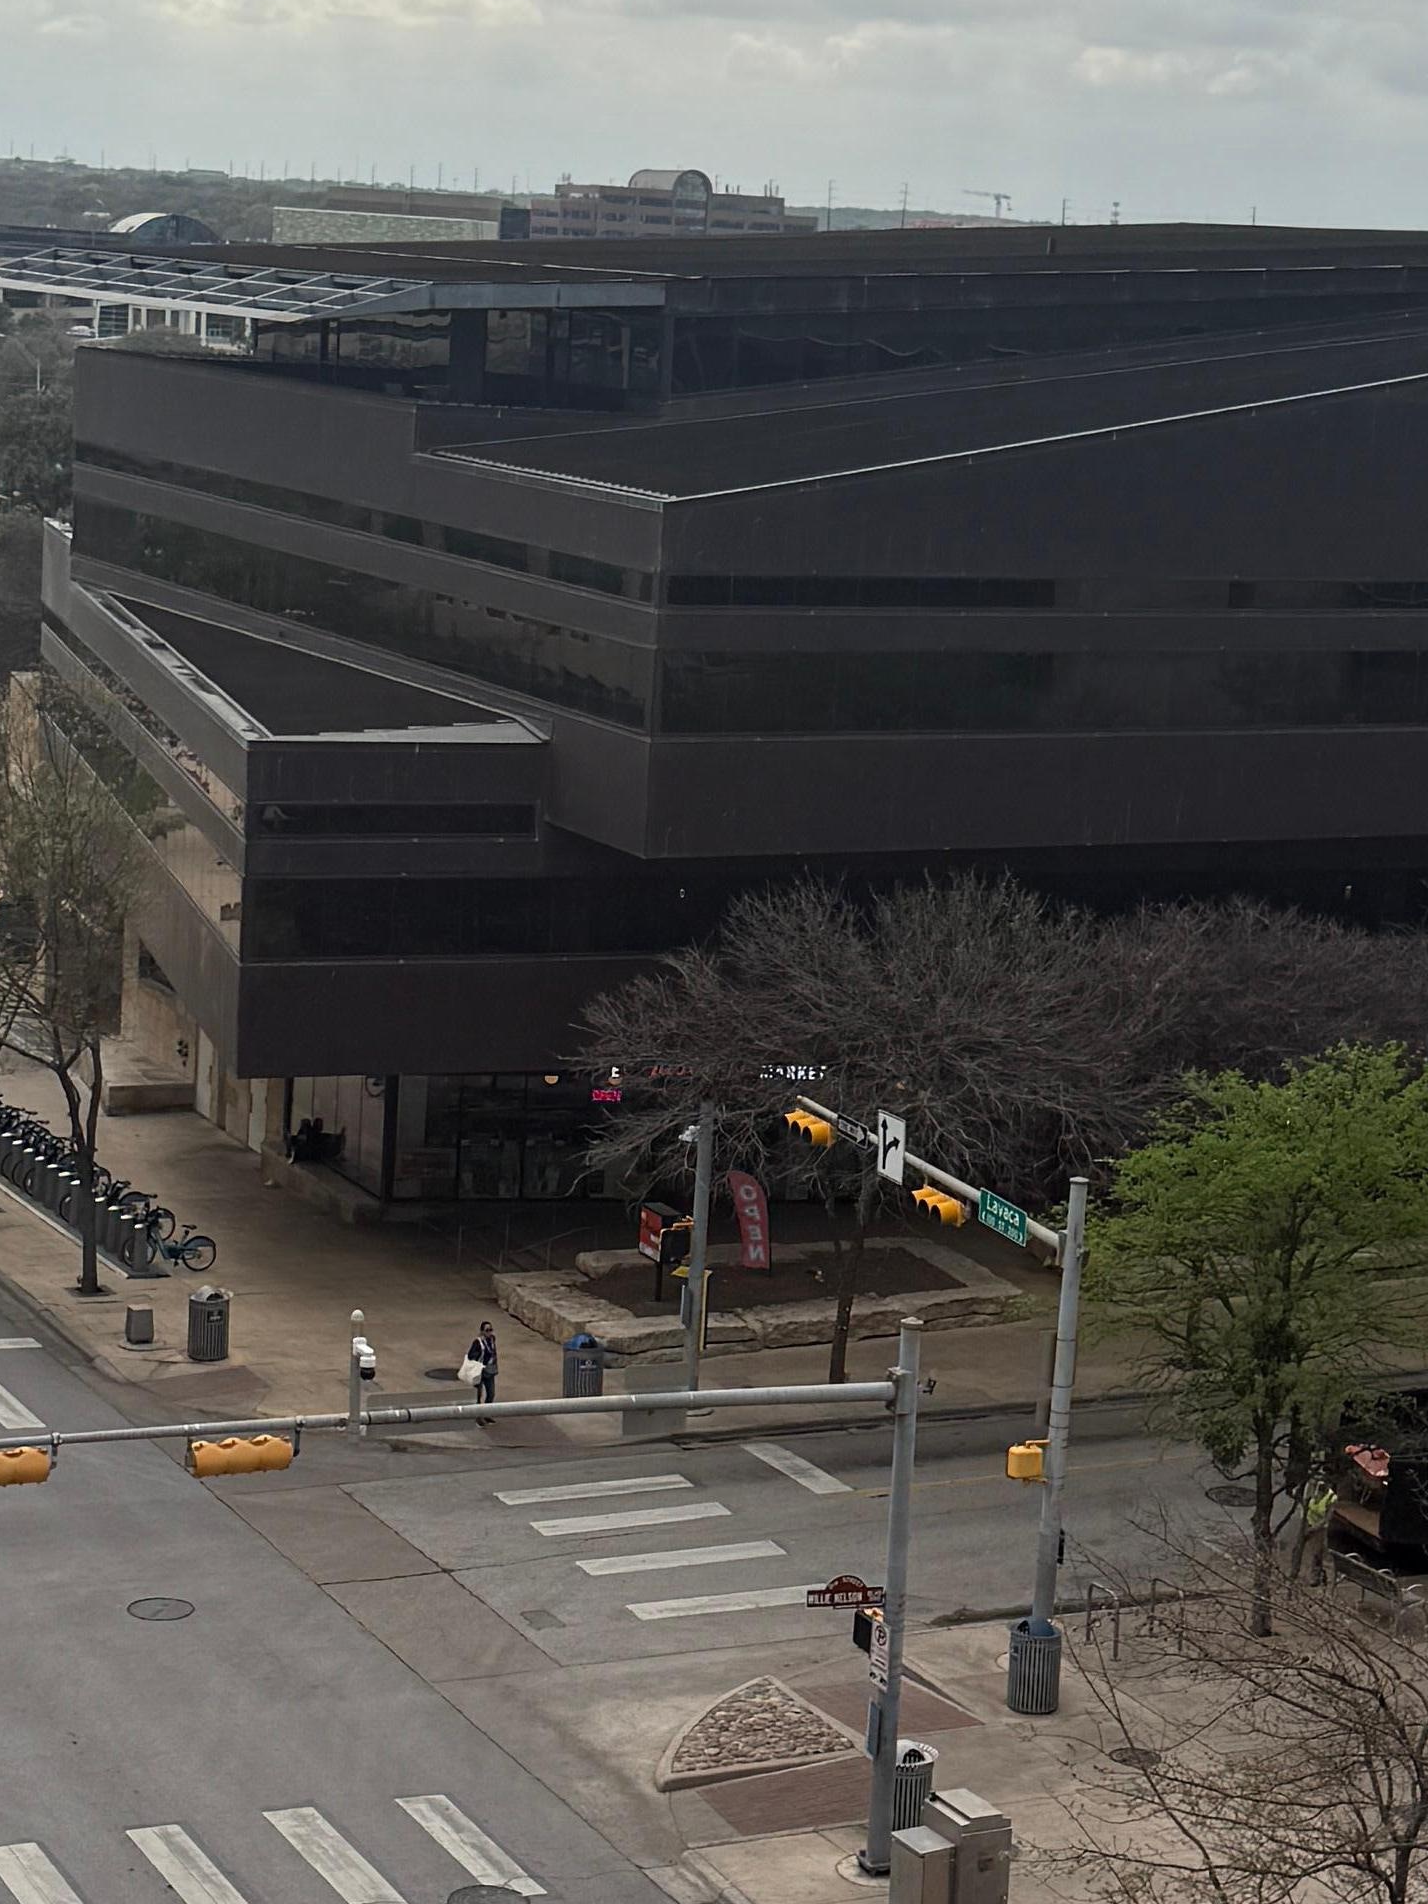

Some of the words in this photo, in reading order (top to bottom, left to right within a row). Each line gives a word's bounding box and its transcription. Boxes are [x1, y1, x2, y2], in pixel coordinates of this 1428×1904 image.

[591, 1089, 623, 1103] OPEN
[986, 1193, 1020, 1227] Lavaca
[808, 1593, 831, 1604] WILLIE
[834, 1591, 863, 1603] NELSON
